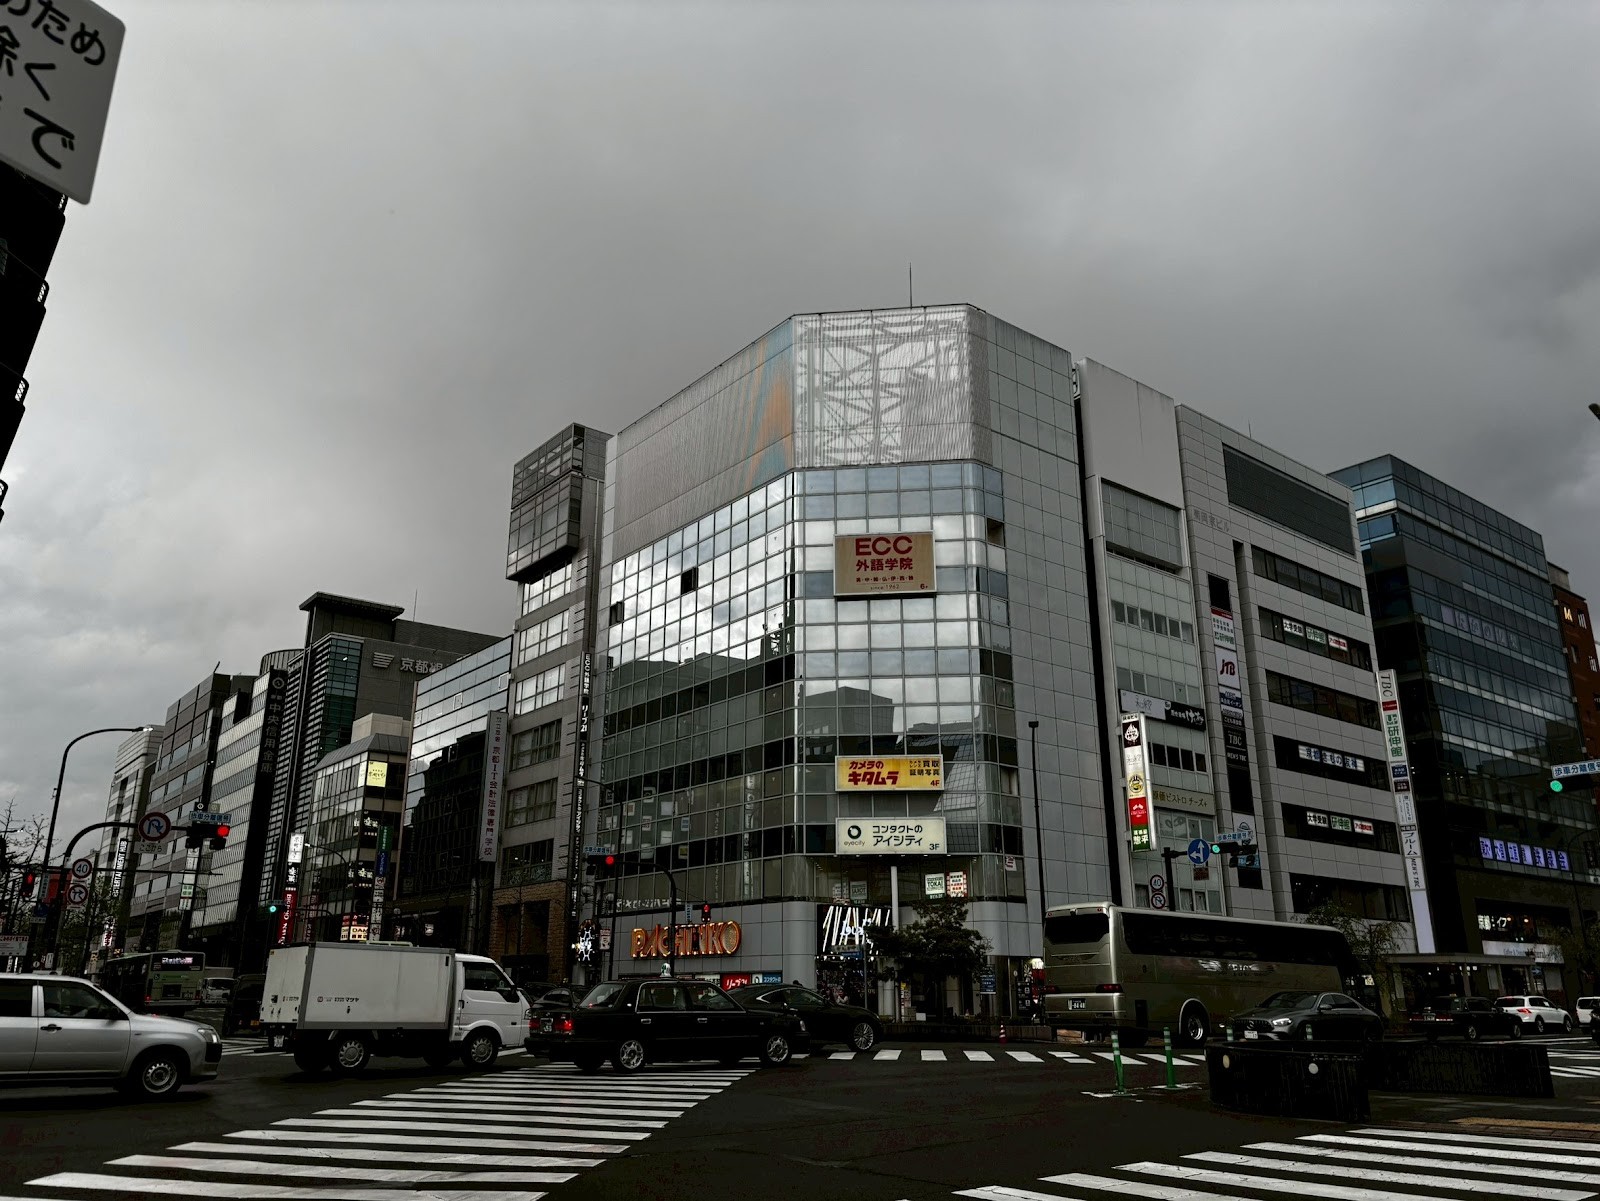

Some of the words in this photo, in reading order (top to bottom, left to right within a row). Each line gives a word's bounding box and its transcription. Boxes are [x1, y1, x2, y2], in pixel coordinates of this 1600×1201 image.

[855, 535, 913, 556] ECC
[856, 557, 913, 572] 外語学院
[1381, 674, 1393, 697] TBC
[1228, 734, 1242, 746] TBC
[1387, 726, 1403, 757] 研伸館
[849, 760, 884, 770] カメラの
[922, 760, 940, 768] 買取
[848, 770, 900, 786] キタムラ
[909, 768, 940, 776] 証明写真
[872, 824, 923, 834] コンタクトの
[872, 835, 923, 847] アイシティ
[929, 843, 940, 851] 3F
[76, 864, 89, 874] 40
[1153, 879, 1162, 887] 40
[631, 921, 740, 957] PACHINKO
